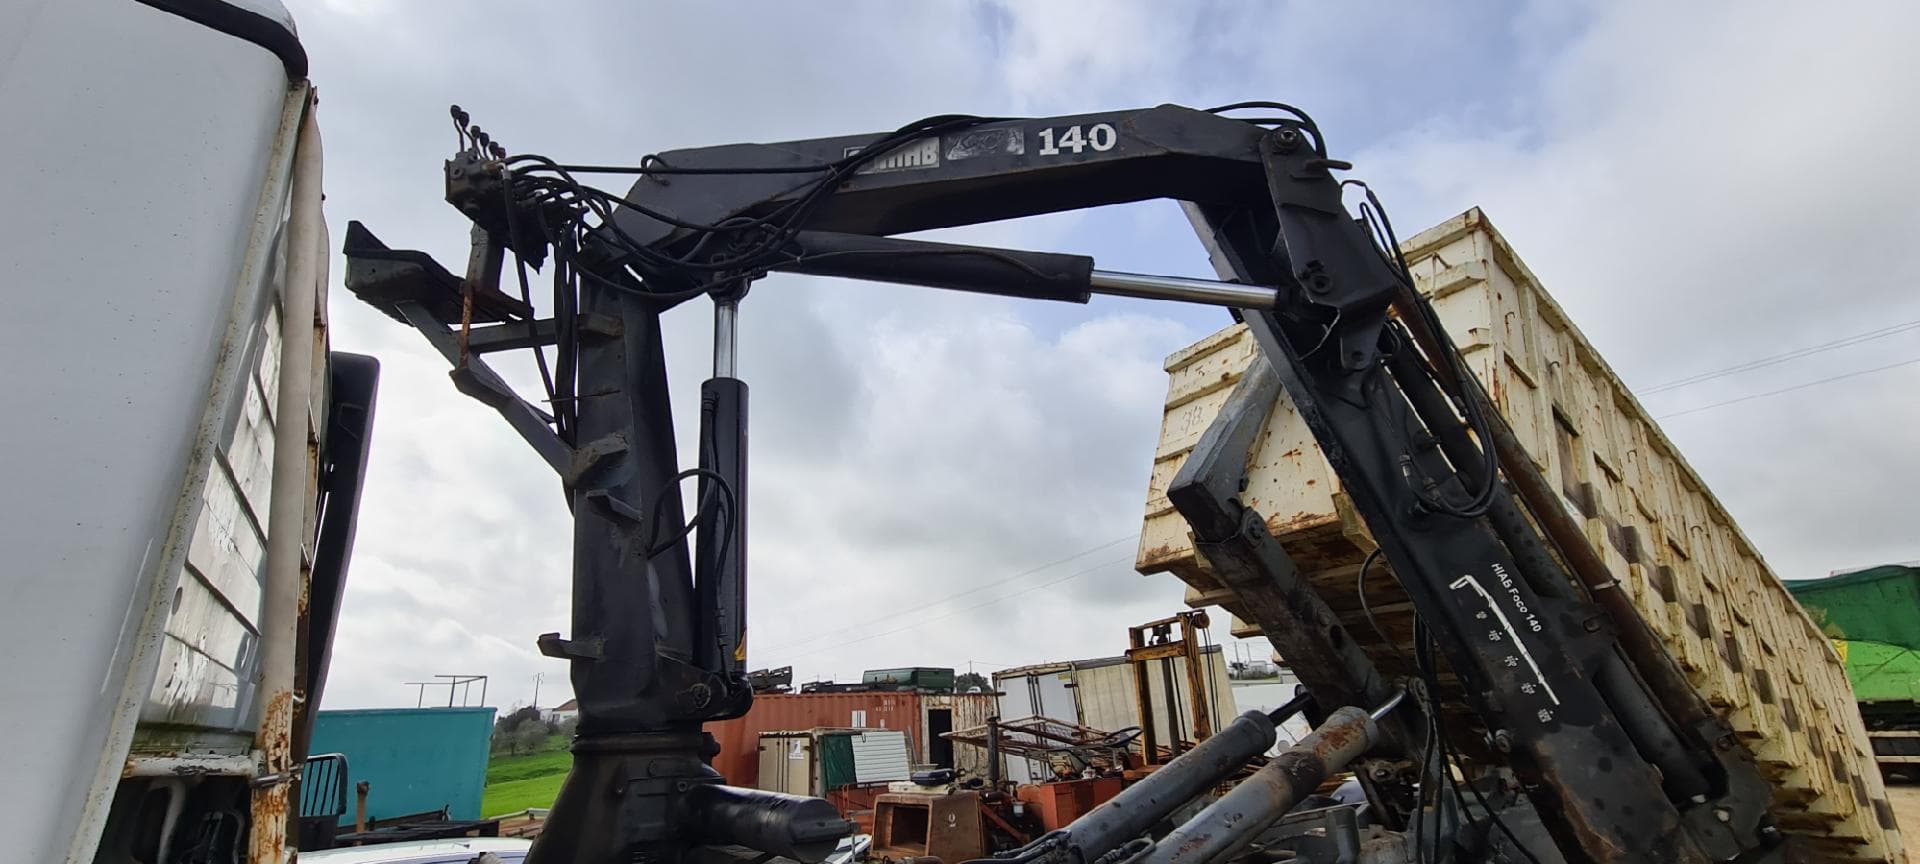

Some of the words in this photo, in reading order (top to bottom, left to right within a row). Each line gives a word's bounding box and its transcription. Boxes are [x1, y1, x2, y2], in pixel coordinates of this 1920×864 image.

[1038, 123, 1117, 155] 140
[1491, 563, 1513, 588] HIAB
[1525, 613, 1542, 632] 140
